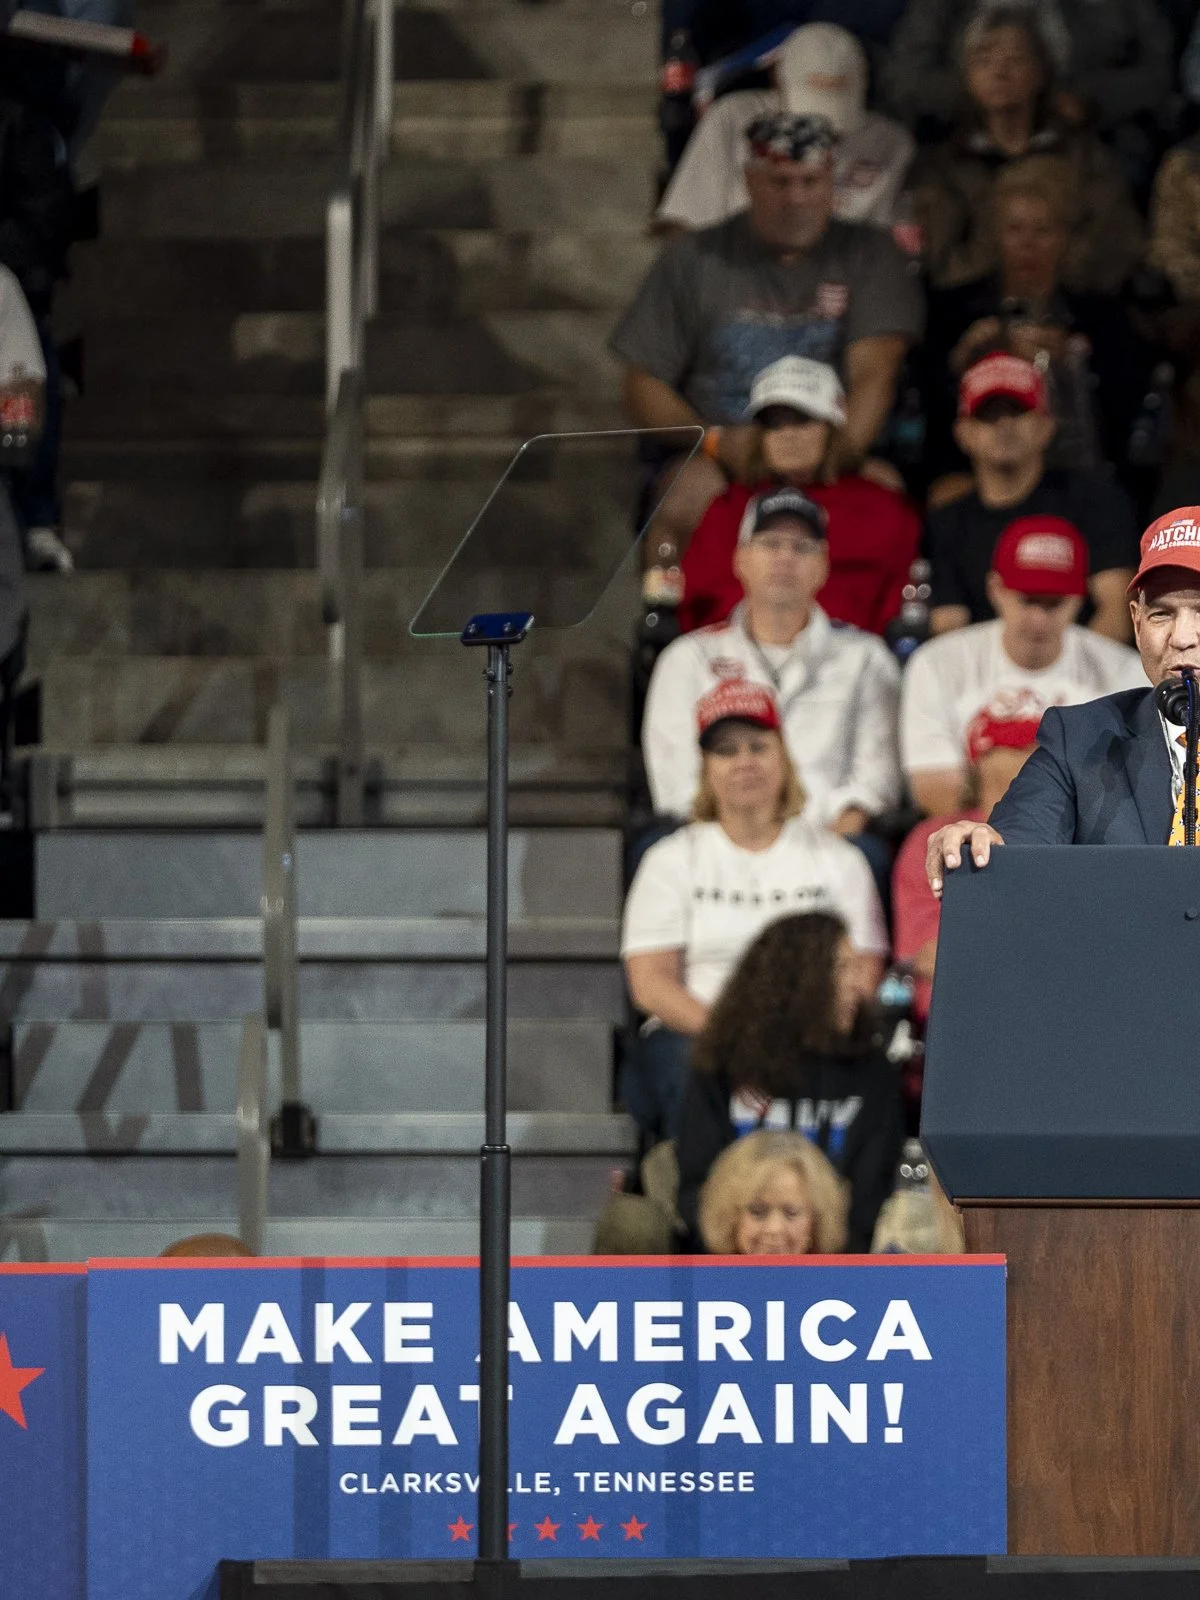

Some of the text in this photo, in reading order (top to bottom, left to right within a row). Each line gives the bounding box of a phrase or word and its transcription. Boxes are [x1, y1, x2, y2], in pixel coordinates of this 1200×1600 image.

[159, 1302, 434, 1365] MAKE
[553, 1382, 905, 1446] AGAIN!
[339, 1471, 755, 1496] CLARKSVLE, TENNESSEE
